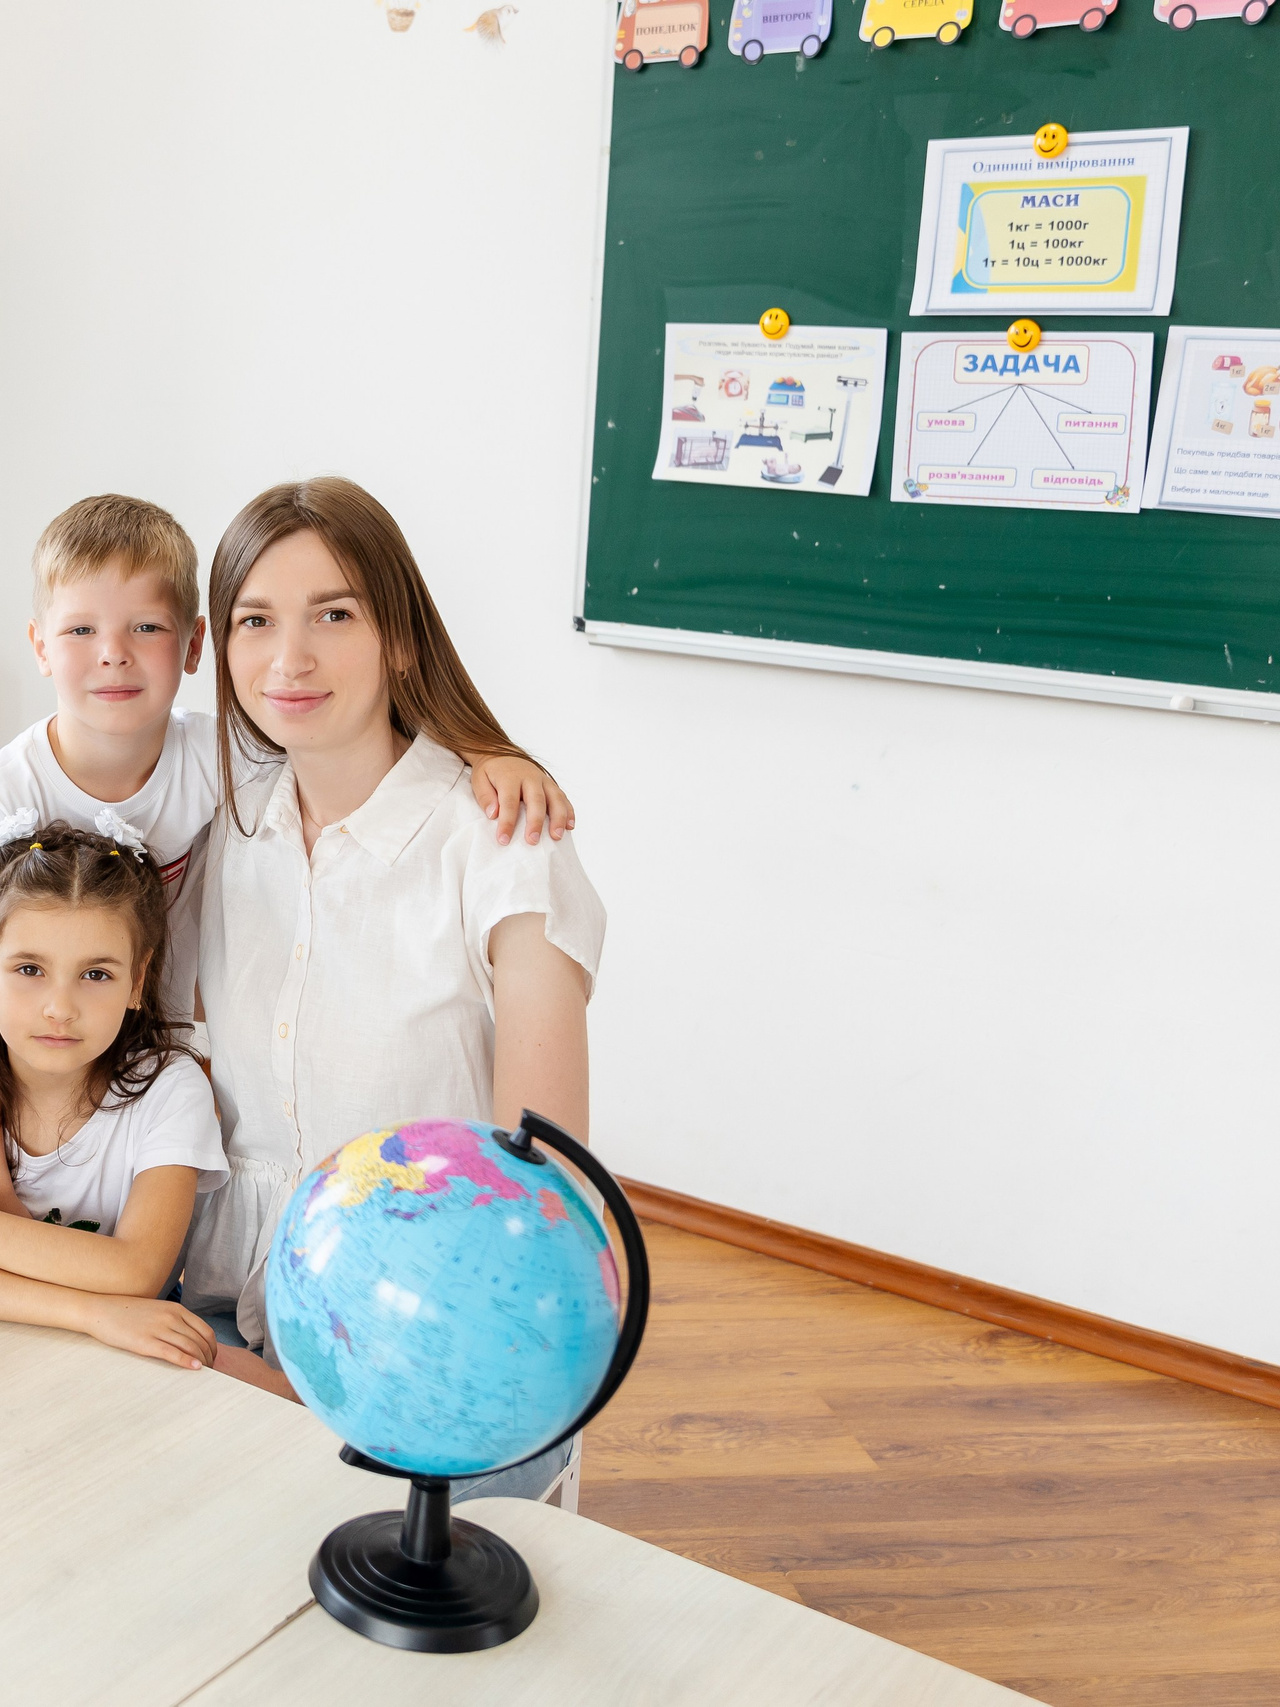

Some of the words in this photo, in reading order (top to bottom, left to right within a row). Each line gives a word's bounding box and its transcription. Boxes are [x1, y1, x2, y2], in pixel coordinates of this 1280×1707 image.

[762, 12, 813, 24] ВІВТОРОК
[636, 22, 698, 36] ПОНЕДІЛОК
[972, 159, 1032, 174] Одиниці
[1036, 156, 1135, 172] вимірювання
[1020, 194, 1080, 208] МАСИ
[1008, 222, 1030, 232] 1кг
[1048, 220, 1089, 231] 1000г
[1009, 240, 1025, 251] 1ц
[1044, 238, 1084, 249] 100кг
[982, 258, 996, 268] 1т
[1014, 257, 1040, 268] 10ц
[1058, 256, 1108, 266] 1000кг
[963, 354, 1080, 377] ЗАДАЧА
[926, 418, 966, 428] умова
[1065, 419, 1118, 429] питання
[1177, 448, 1214, 456] Покупець
[1217, 451, 1250, 459] придбав
[928, 470, 1005, 482] розв'язання
[1043, 475, 1104, 486] відповідь
[1171, 486, 1200, 494] Вибери
